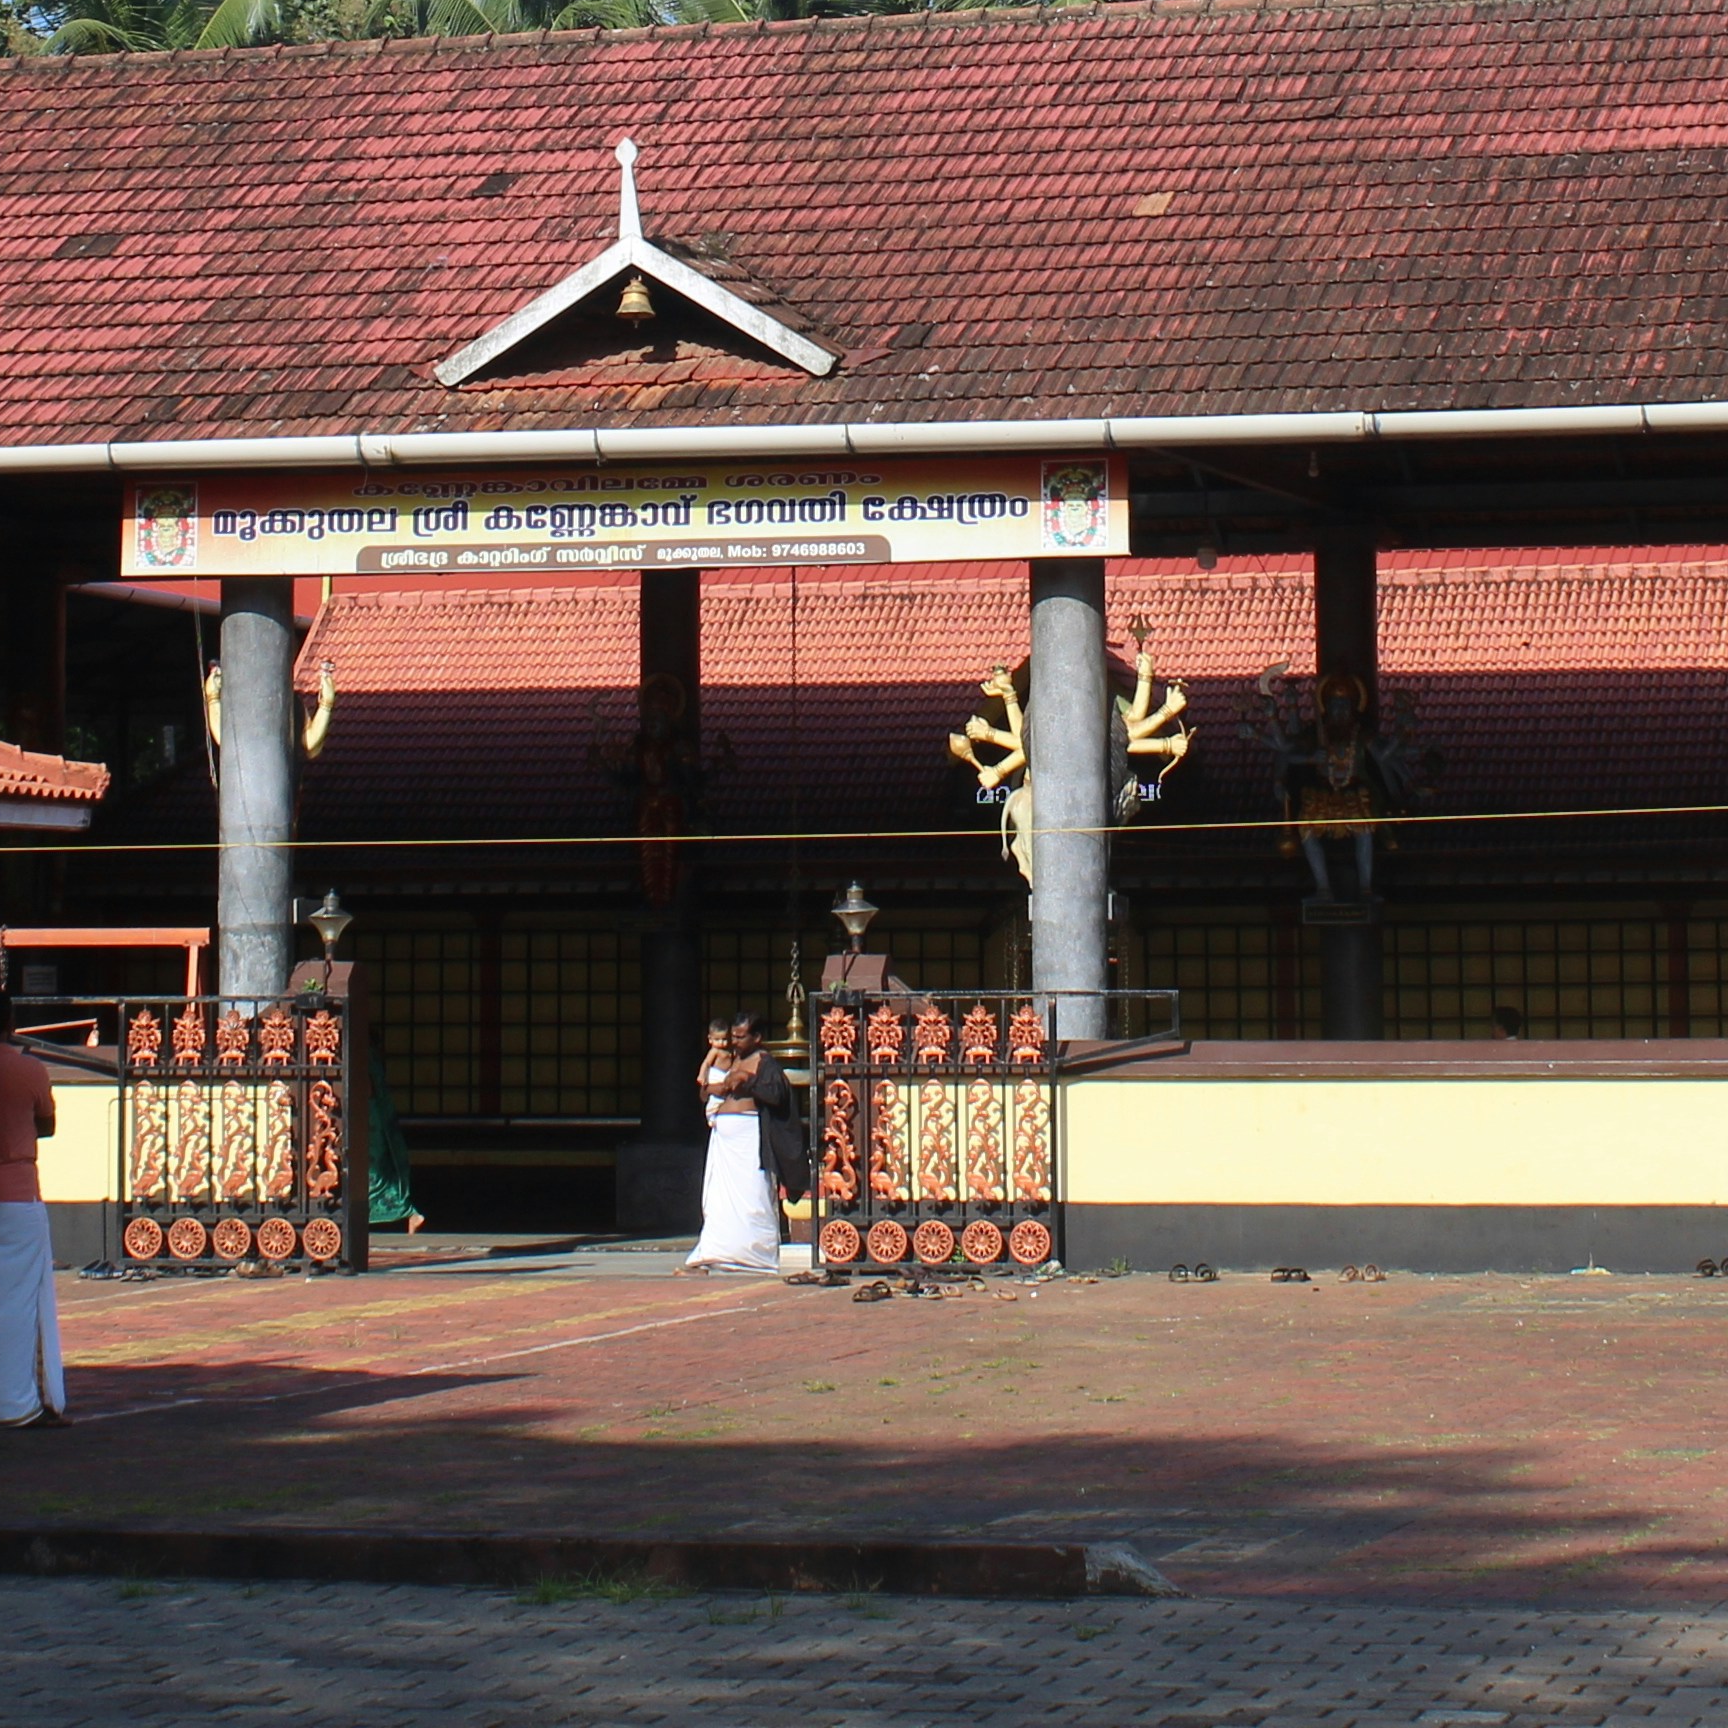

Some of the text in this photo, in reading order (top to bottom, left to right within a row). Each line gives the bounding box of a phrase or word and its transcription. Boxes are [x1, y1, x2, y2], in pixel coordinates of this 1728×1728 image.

[725, 471, 882, 488] ശരണം
[213, 508, 398, 541] മൂക്കുതല
[412, 499, 469, 537] ശ്രീ
[707, 489, 848, 526] ഭഗവതി
[861, 491, 1029, 525] ക്ഷേത്രം
[727, 544, 767, 558] Mob:
[771, 542, 866, 557] 9746988603
